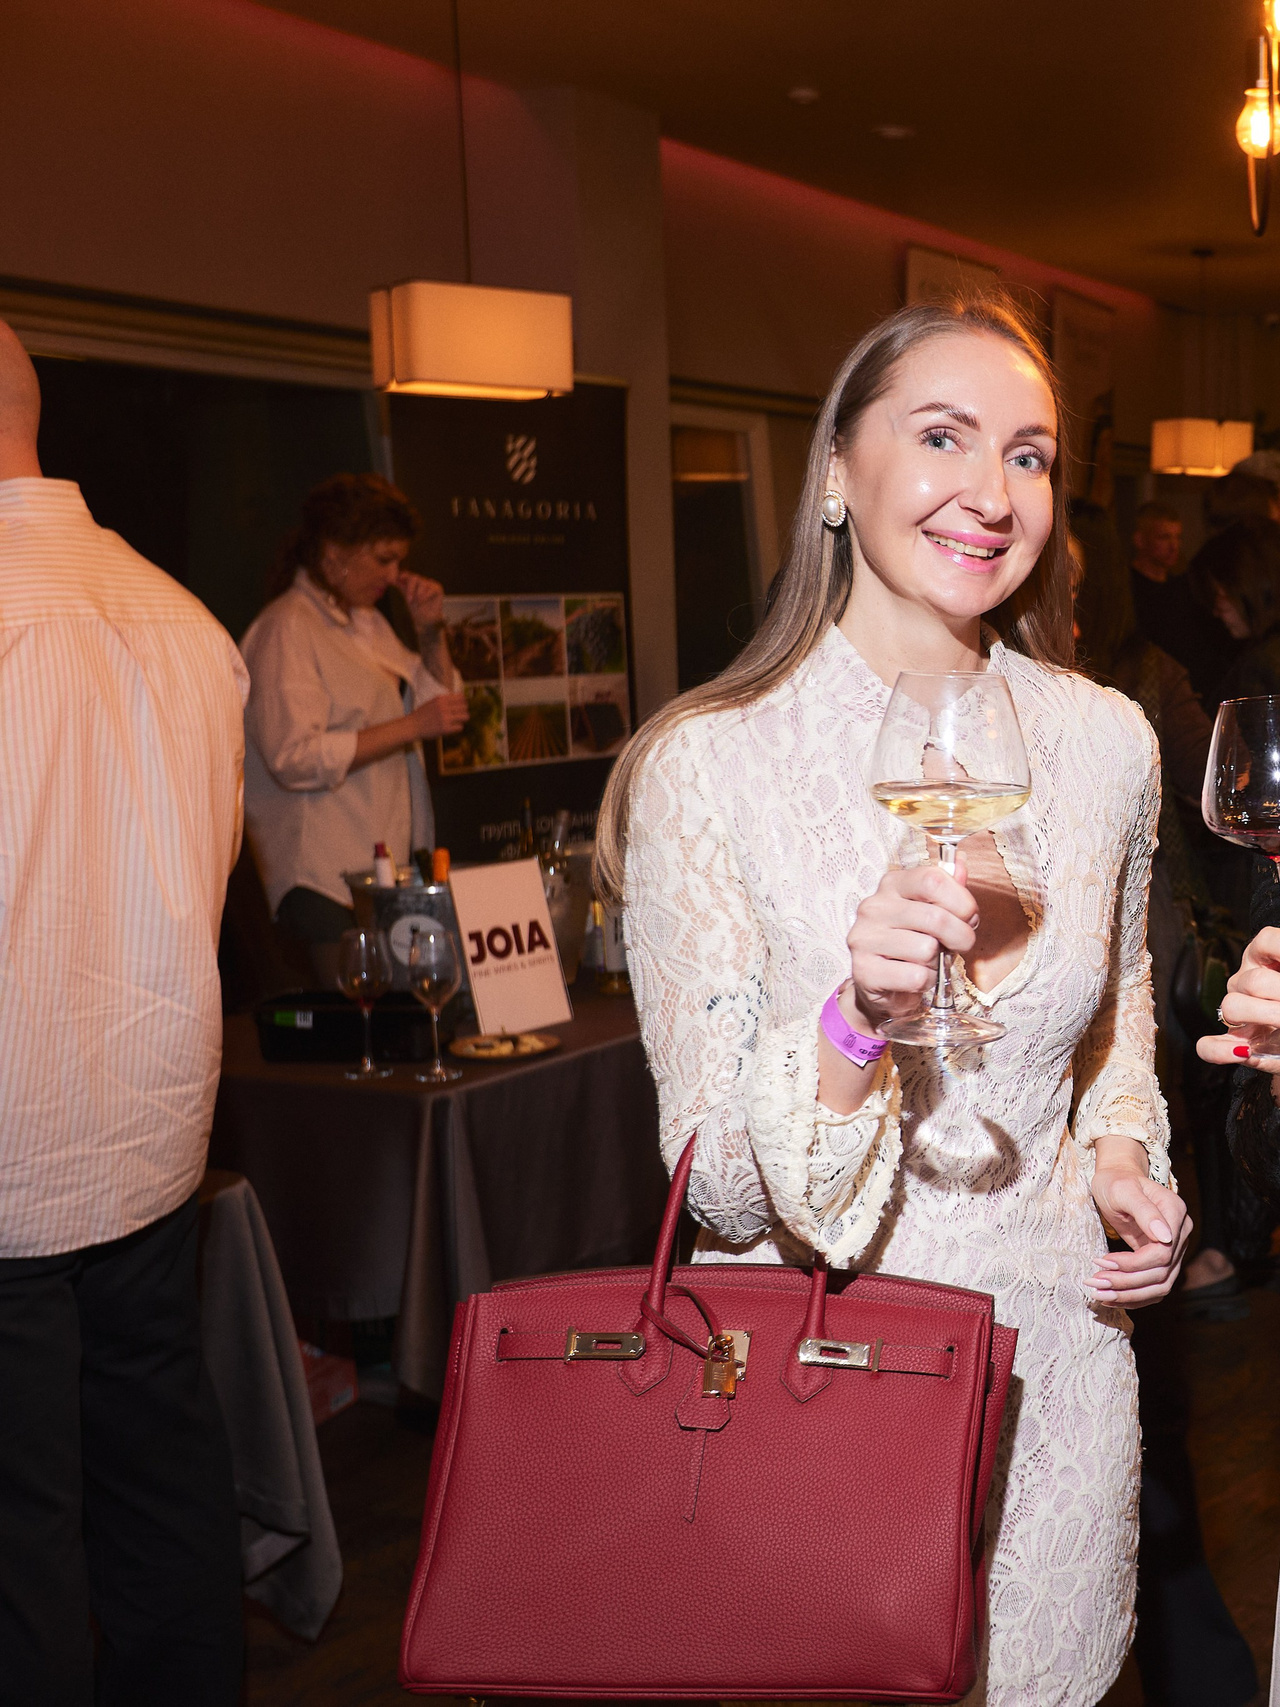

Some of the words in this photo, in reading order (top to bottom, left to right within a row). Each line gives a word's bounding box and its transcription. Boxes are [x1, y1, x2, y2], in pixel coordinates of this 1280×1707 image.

[450, 495, 598, 522] FANAGORIA
[481, 820, 522, 843] ГРУПП
[468, 919, 552, 966] JOIA
